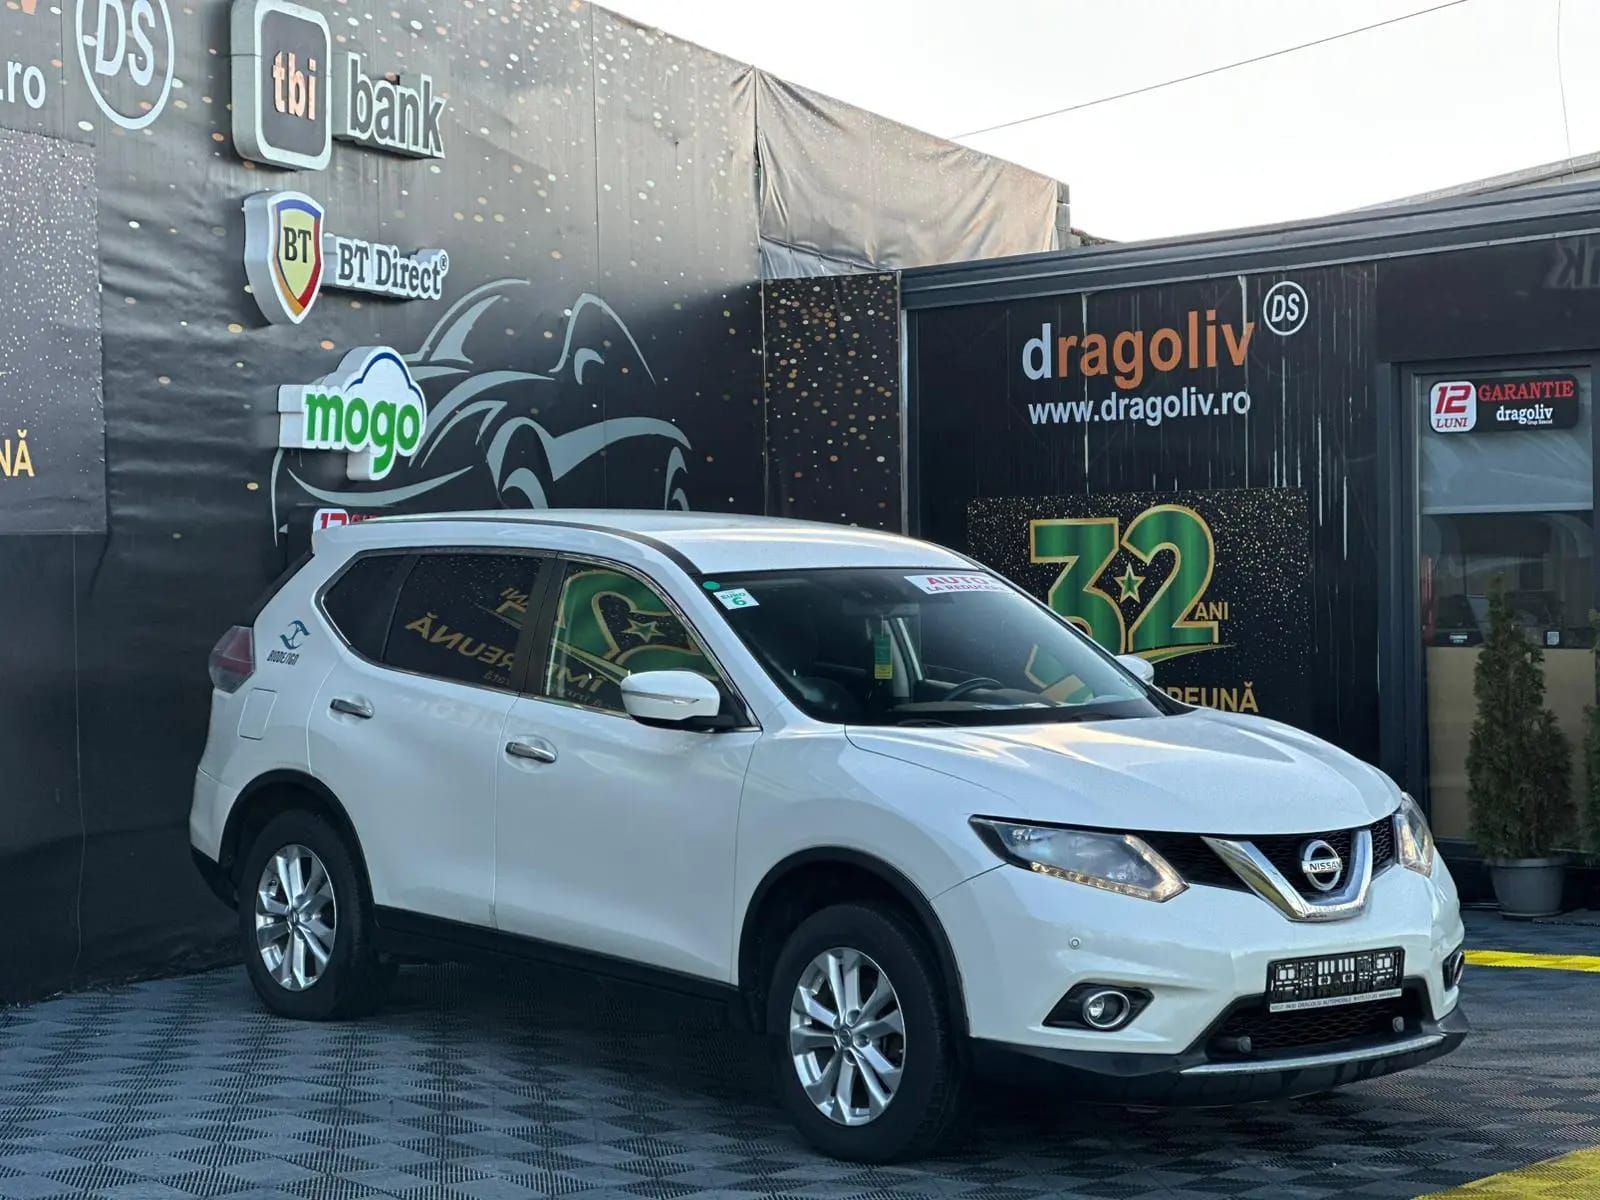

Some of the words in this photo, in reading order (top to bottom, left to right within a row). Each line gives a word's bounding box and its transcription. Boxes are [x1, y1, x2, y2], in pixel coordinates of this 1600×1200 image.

[95, 0, 155, 86] DS
[273, 51, 317, 120] tbi
[348, 53, 445, 158] bank
[283, 227, 313, 264] BT
[338, 242, 370, 283] BT
[1271, 293, 1300, 323] DS
[1022, 309, 1256, 390] dragoliv
[1028, 387, 1251, 427] www.dragoliv.ro
[1434, 385, 1472, 415] 12
[1478, 381, 1574, 401] GARANTIE
[305, 392, 422, 473] mogo
[1436, 417, 1468, 429] LUNI
[1496, 403, 1554, 425] dragoliv
[1030, 504, 1219, 654] 32
[732, 596, 747, 606] 6
[1194, 601, 1229, 621] ANI
[1309, 860, 1341, 871] NISSAN
